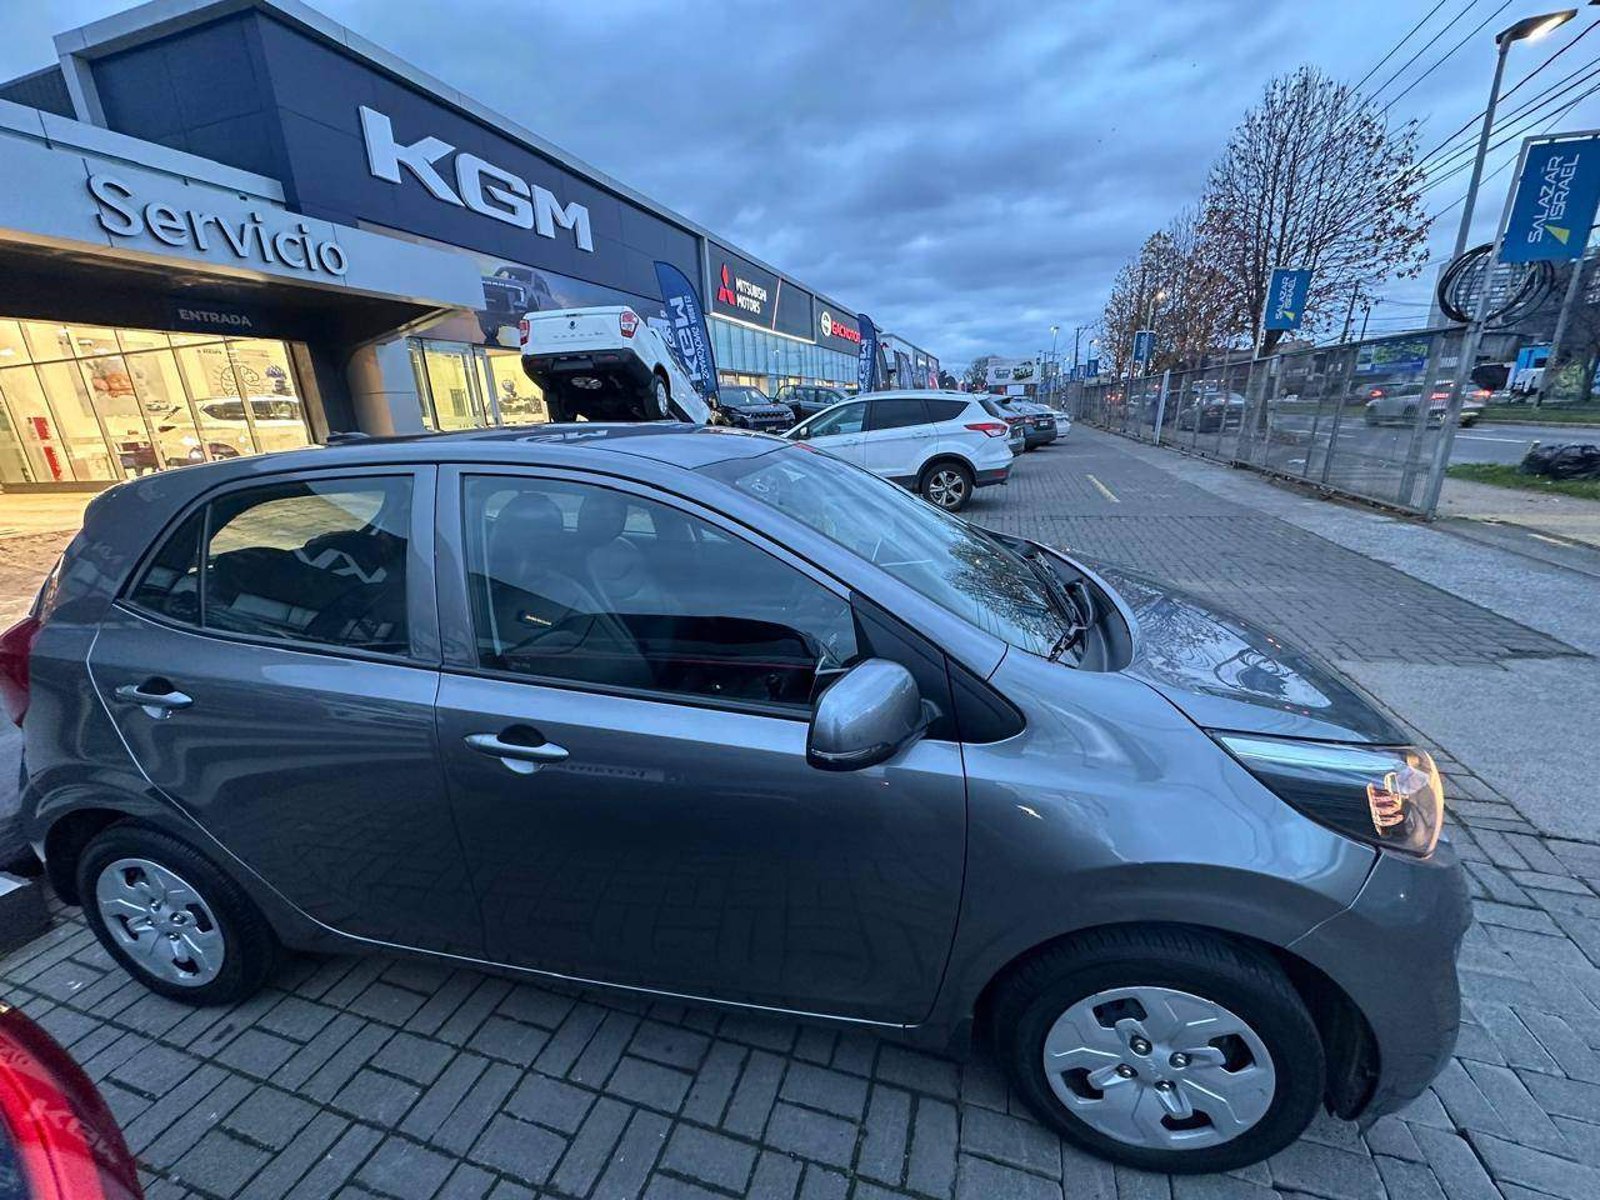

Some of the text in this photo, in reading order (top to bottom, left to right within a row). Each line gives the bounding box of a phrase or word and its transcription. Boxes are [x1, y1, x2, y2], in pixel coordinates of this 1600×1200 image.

[358, 105, 595, 252] KGM
[1527, 155, 1564, 243] SALAZAR
[1548, 153, 1580, 220] ISRAEL
[87, 172, 349, 276] Servicio
[735, 277, 767, 302] MITSUBISHI
[736, 293, 761, 314] MOTORS
[1275, 276, 1290, 320] SALAZAR
[1284, 275, 1297, 309] ISRAEL
[178, 309, 253, 328] ENTRADA
